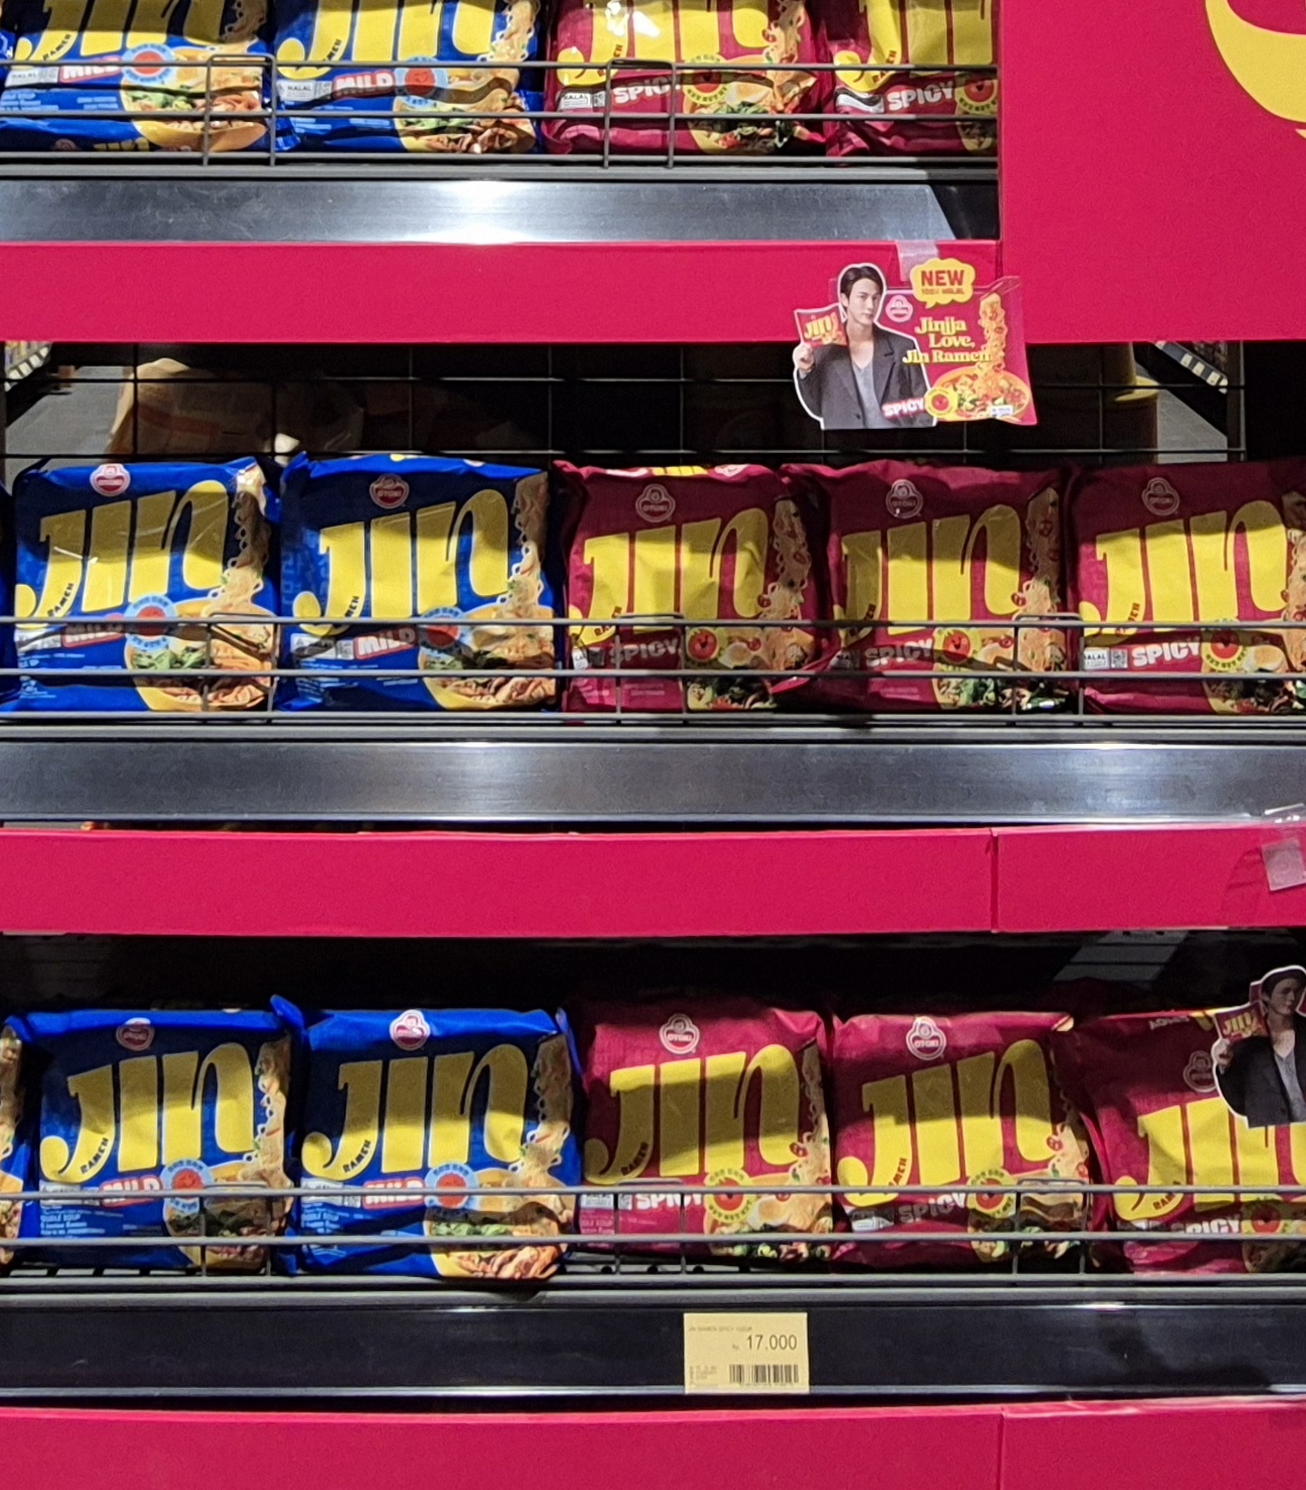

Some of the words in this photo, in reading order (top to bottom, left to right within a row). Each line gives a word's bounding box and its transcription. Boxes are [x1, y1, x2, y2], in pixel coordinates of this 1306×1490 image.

[334, 72, 395, 96] MILD
[888, 83, 954, 110] SPICY
[921, 270, 965, 286] NEW
[914, 317, 967, 336] Jinjja
[929, 334, 975, 349] Love,
[902, 350, 930, 364] Jin
[932, 350, 991, 363] Ramen
[881, 397, 925, 418] SPICY
[356, 627, 416, 658] MILD
[864, 638, 933, 667] SPICY
[1131, 641, 1201, 669] SPICY
[81, 1138, 109, 1175] RAMEN
[342, 1138, 372, 1174] RAMEN
[621, 1142, 649, 1176] RAMEN
[102, 1177, 162, 1206] MILD
[746, 1334, 797, 1351] 17.000
